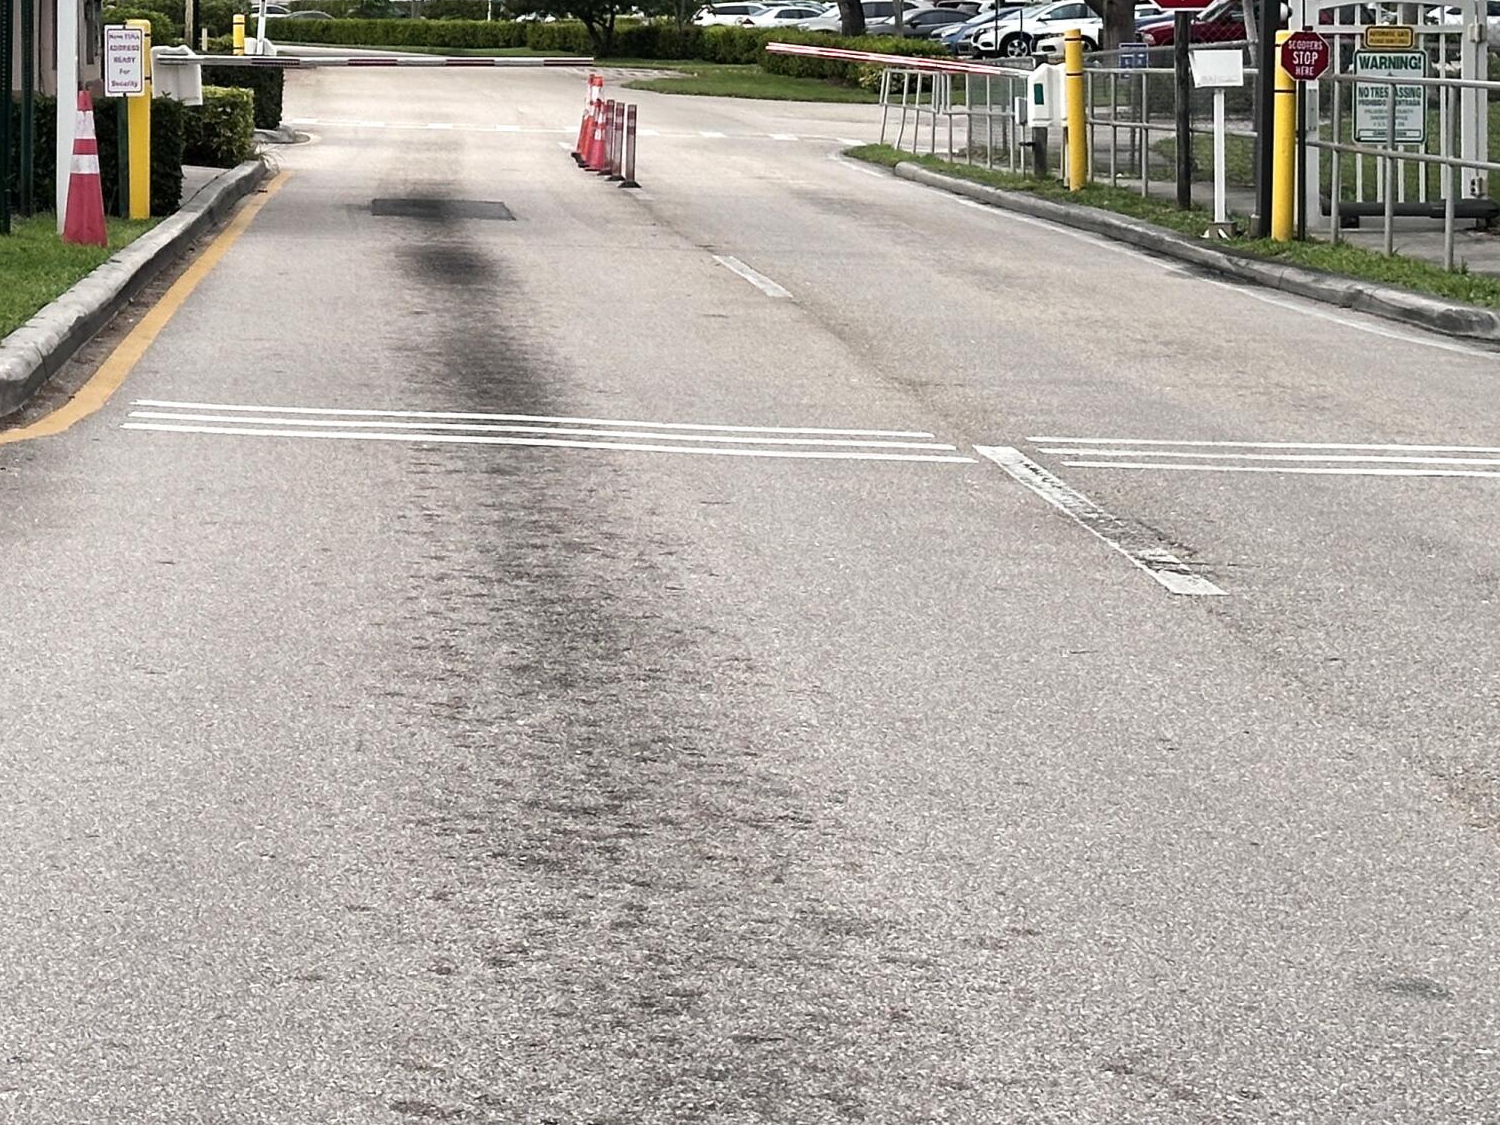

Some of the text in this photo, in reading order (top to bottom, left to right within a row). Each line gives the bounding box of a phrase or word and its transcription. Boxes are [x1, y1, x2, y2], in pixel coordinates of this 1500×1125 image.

[1288, 40, 1323, 51] SCOOTERS
[1292, 51, 1319, 65] STOP
[1359, 55, 1422, 70] WARNING!
[1295, 66, 1315, 76] HERE
[1358, 86, 1422, 98] NO TRESASSING
